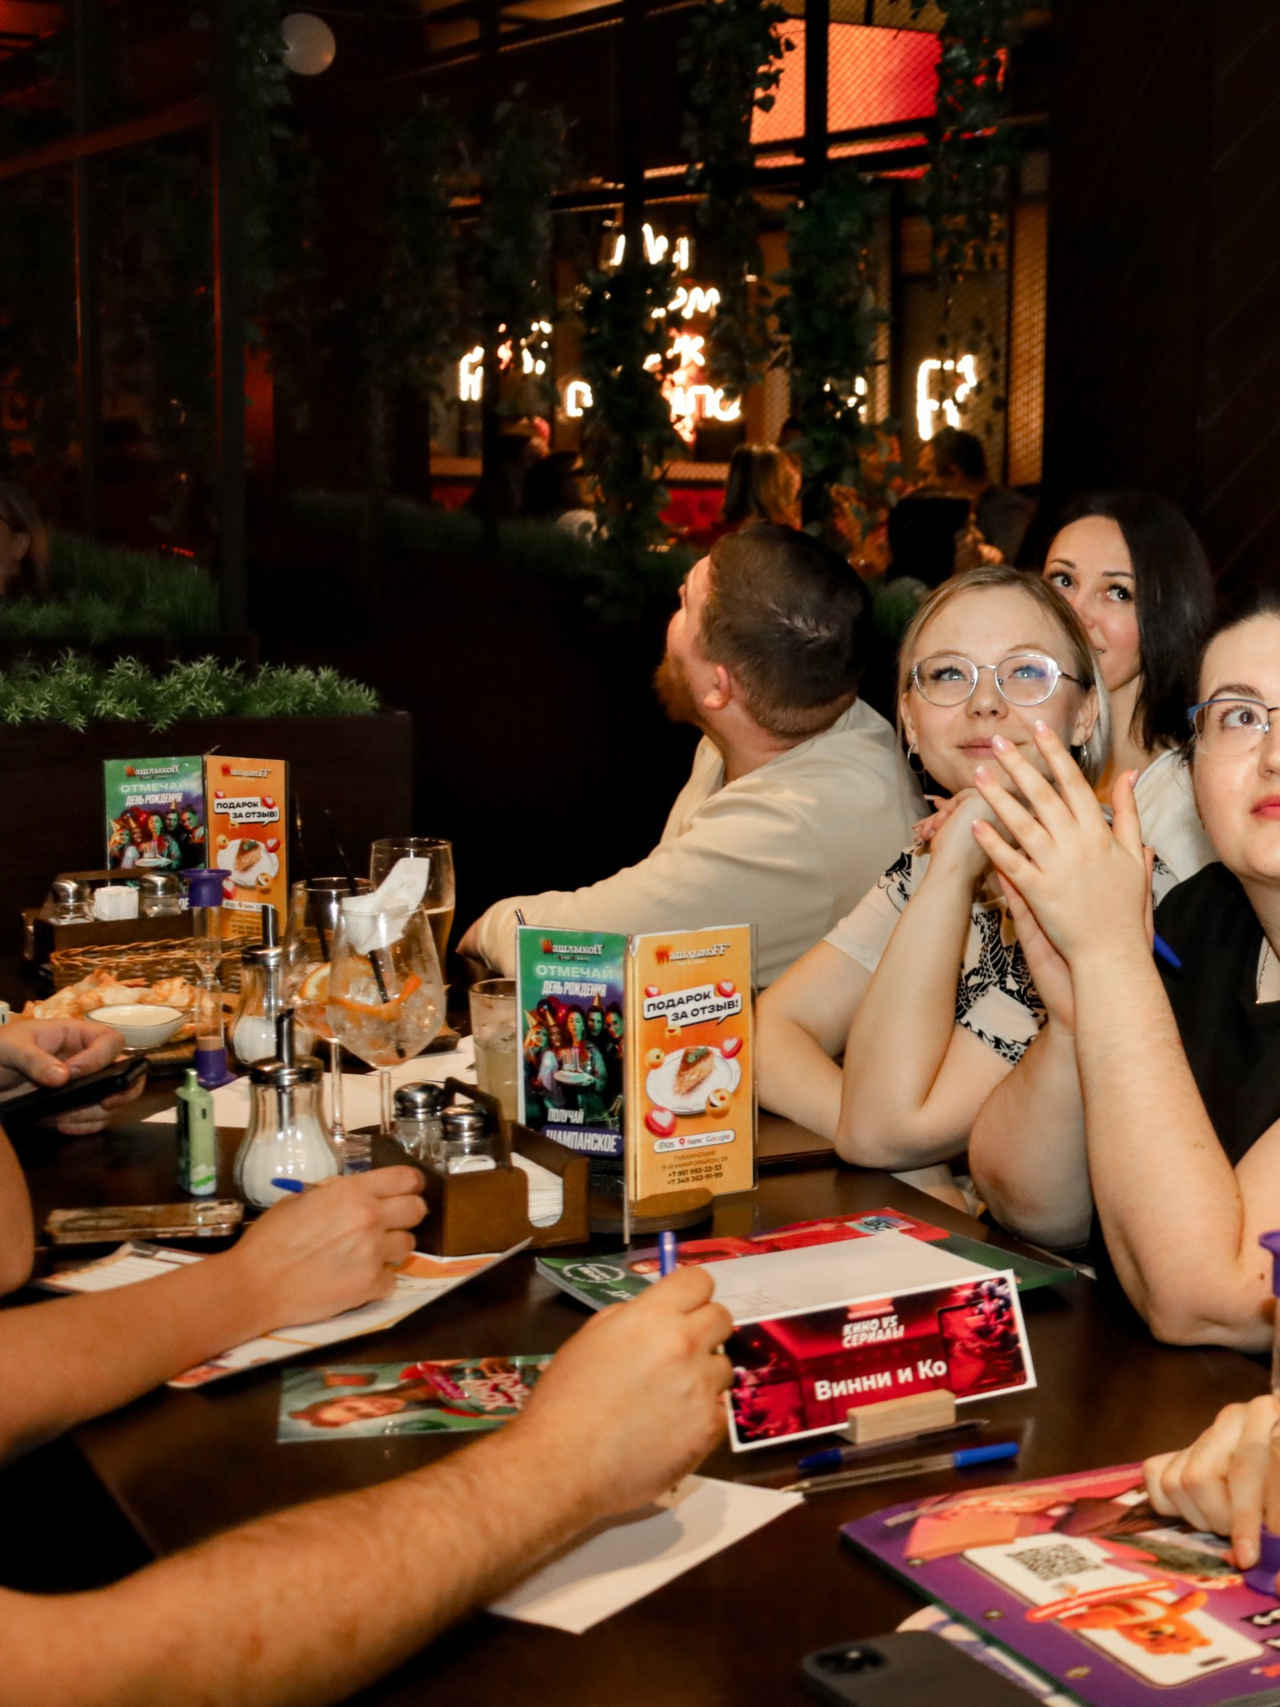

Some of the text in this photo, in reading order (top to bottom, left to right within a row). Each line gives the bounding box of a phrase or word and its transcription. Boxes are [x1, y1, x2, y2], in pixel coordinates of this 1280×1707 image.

[120, 782, 190, 793] ОТМЕЧАЙ
[125, 795, 144, 806] ДЕНЬ
[216, 801, 259, 810] ПОДАРОК
[245, 811, 278, 819] ОТЗЫВ!
[535, 964, 613, 979] ОТМЕЧАЙ
[541, 980, 607, 997] ДЕНЬ РОЖДЕНИЯ
[647, 990, 712, 1012] ПОДАРОК
[671, 999, 739, 1021] ЗА ОТЗЫВ!
[547, 1107, 585, 1124] ПОЛУЧАЙ
[843, 1314, 899, 1337] КИНО VS
[842, 1324, 906, 1348] СЕРИАЛЫ
[814, 1358, 948, 1401] Винни и Ко
